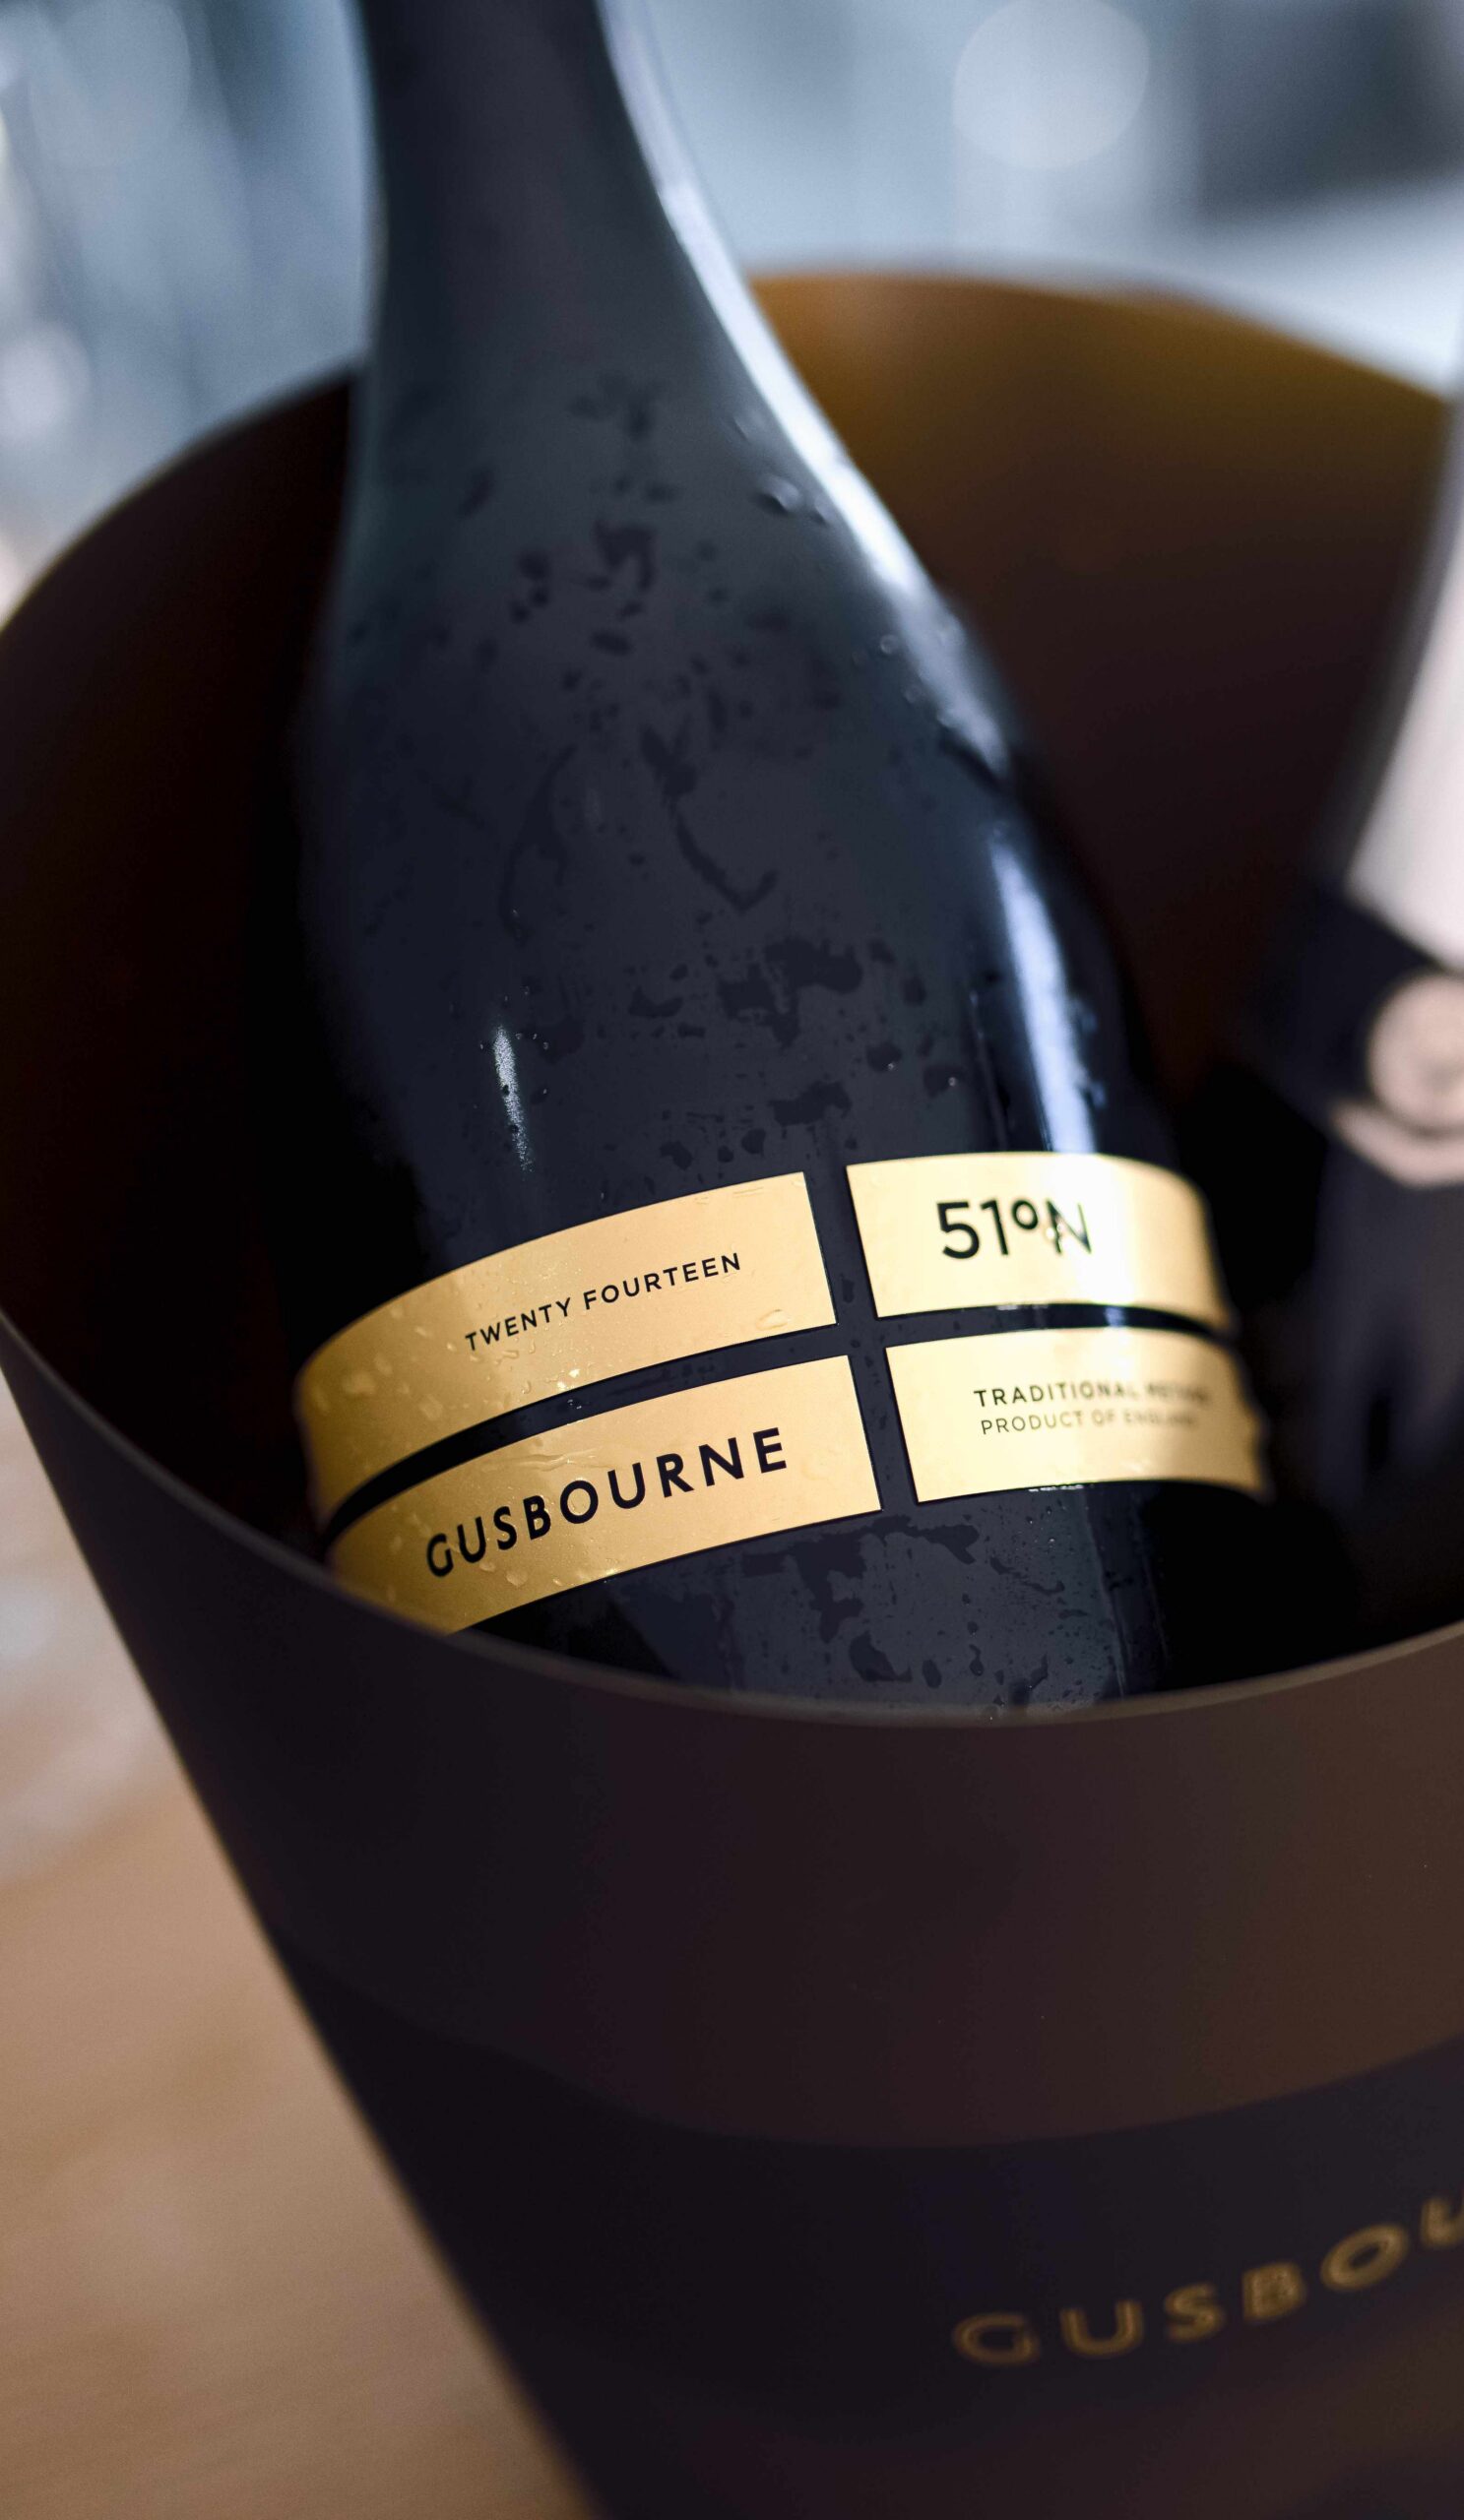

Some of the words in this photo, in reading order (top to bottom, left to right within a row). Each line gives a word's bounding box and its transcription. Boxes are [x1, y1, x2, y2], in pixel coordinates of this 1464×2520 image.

[465, 1297, 572, 1352] TWENTY
[583, 1252, 741, 1310] FOURTEEN
[973, 1380, 1140, 1408] TRADITIONAL
[980, 1409, 1084, 1435] PRODUCT
[1091, 1408, 1116, 1426] OF
[425, 1427, 788, 1578] GUSBOURNE
